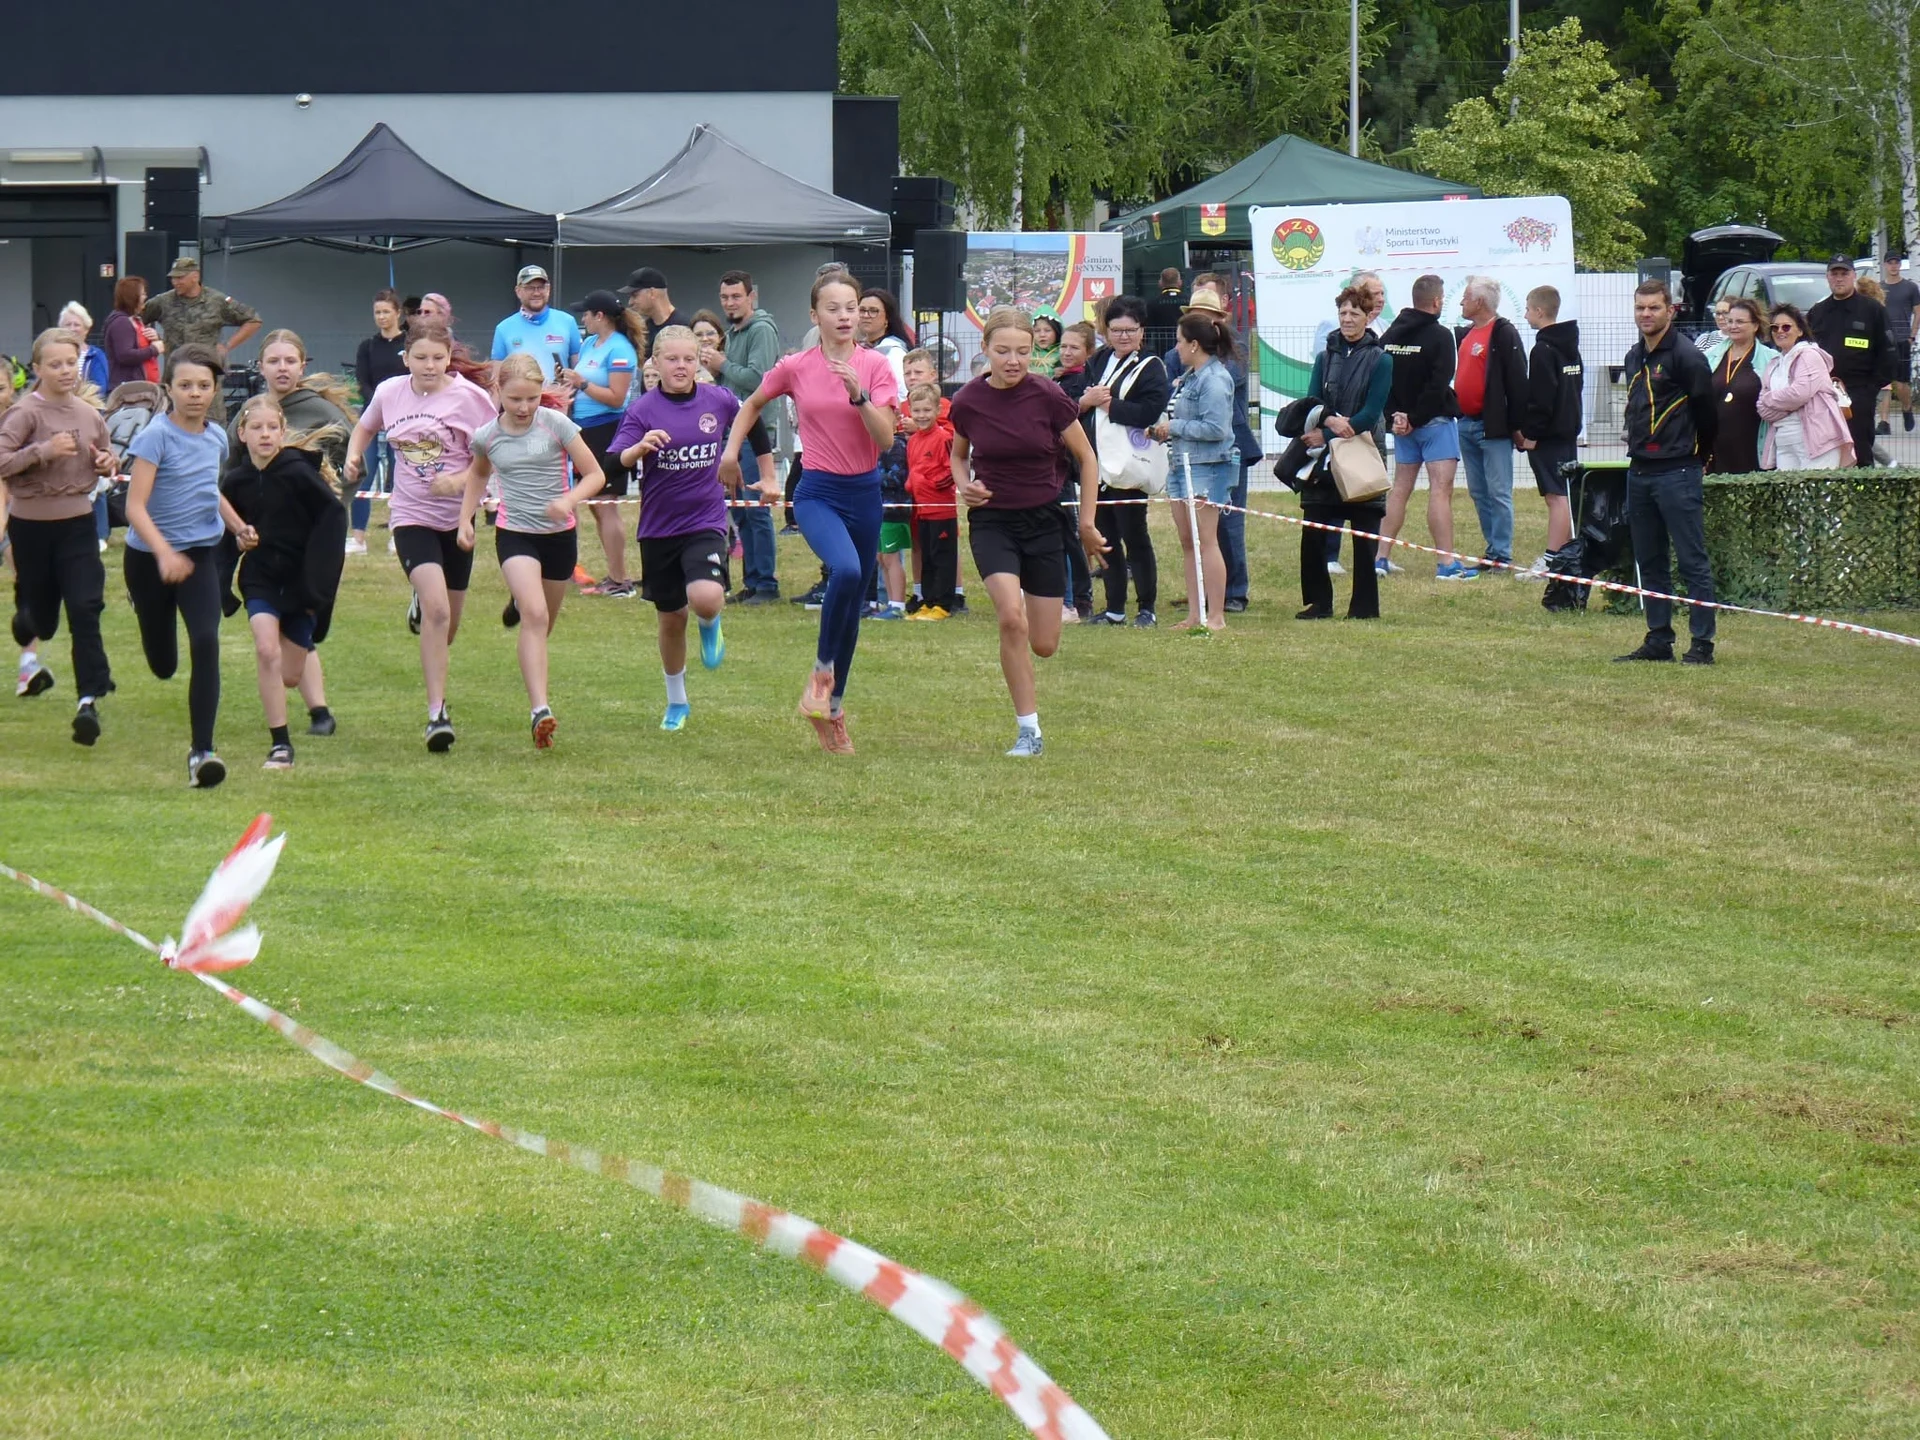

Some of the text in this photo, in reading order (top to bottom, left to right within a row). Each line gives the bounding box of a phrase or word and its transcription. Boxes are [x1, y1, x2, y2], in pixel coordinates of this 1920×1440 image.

[1278, 220, 1315, 237] LZS
[1385, 227, 1441, 237] Ministerstwo
[1385, 238, 1415, 248] Sportu
[1420, 235, 1459, 247] Turystyki
[1083, 255, 1113, 264] Gmina
[1075, 263, 1122, 272] KNYSZYN
[658, 442, 718, 461] SOCCER
[657, 461, 680, 471] SALON
